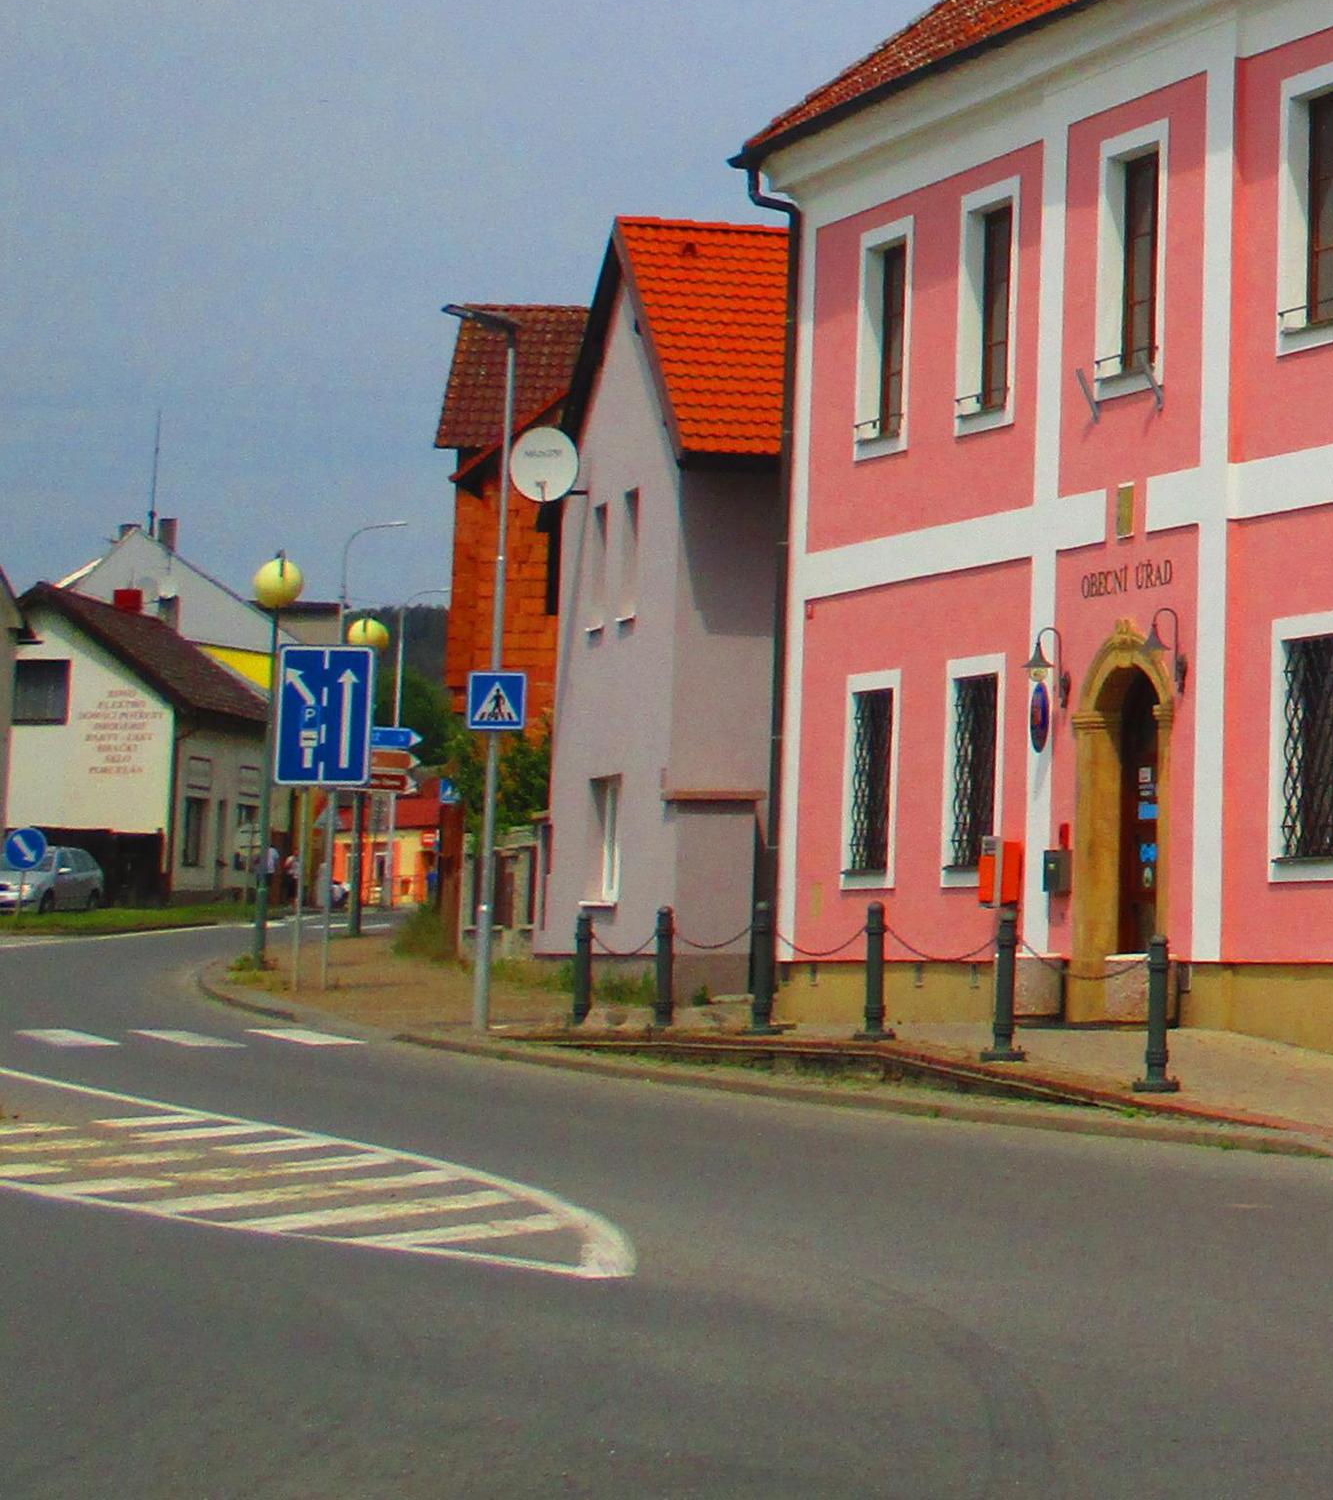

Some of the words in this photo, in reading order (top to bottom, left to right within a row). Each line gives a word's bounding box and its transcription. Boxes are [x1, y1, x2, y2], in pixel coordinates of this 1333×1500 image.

[1081, 565, 1128, 599] OBECNÍ
[1135, 558, 1173, 590] ÚŘAD
[305, 707, 316, 721] P
